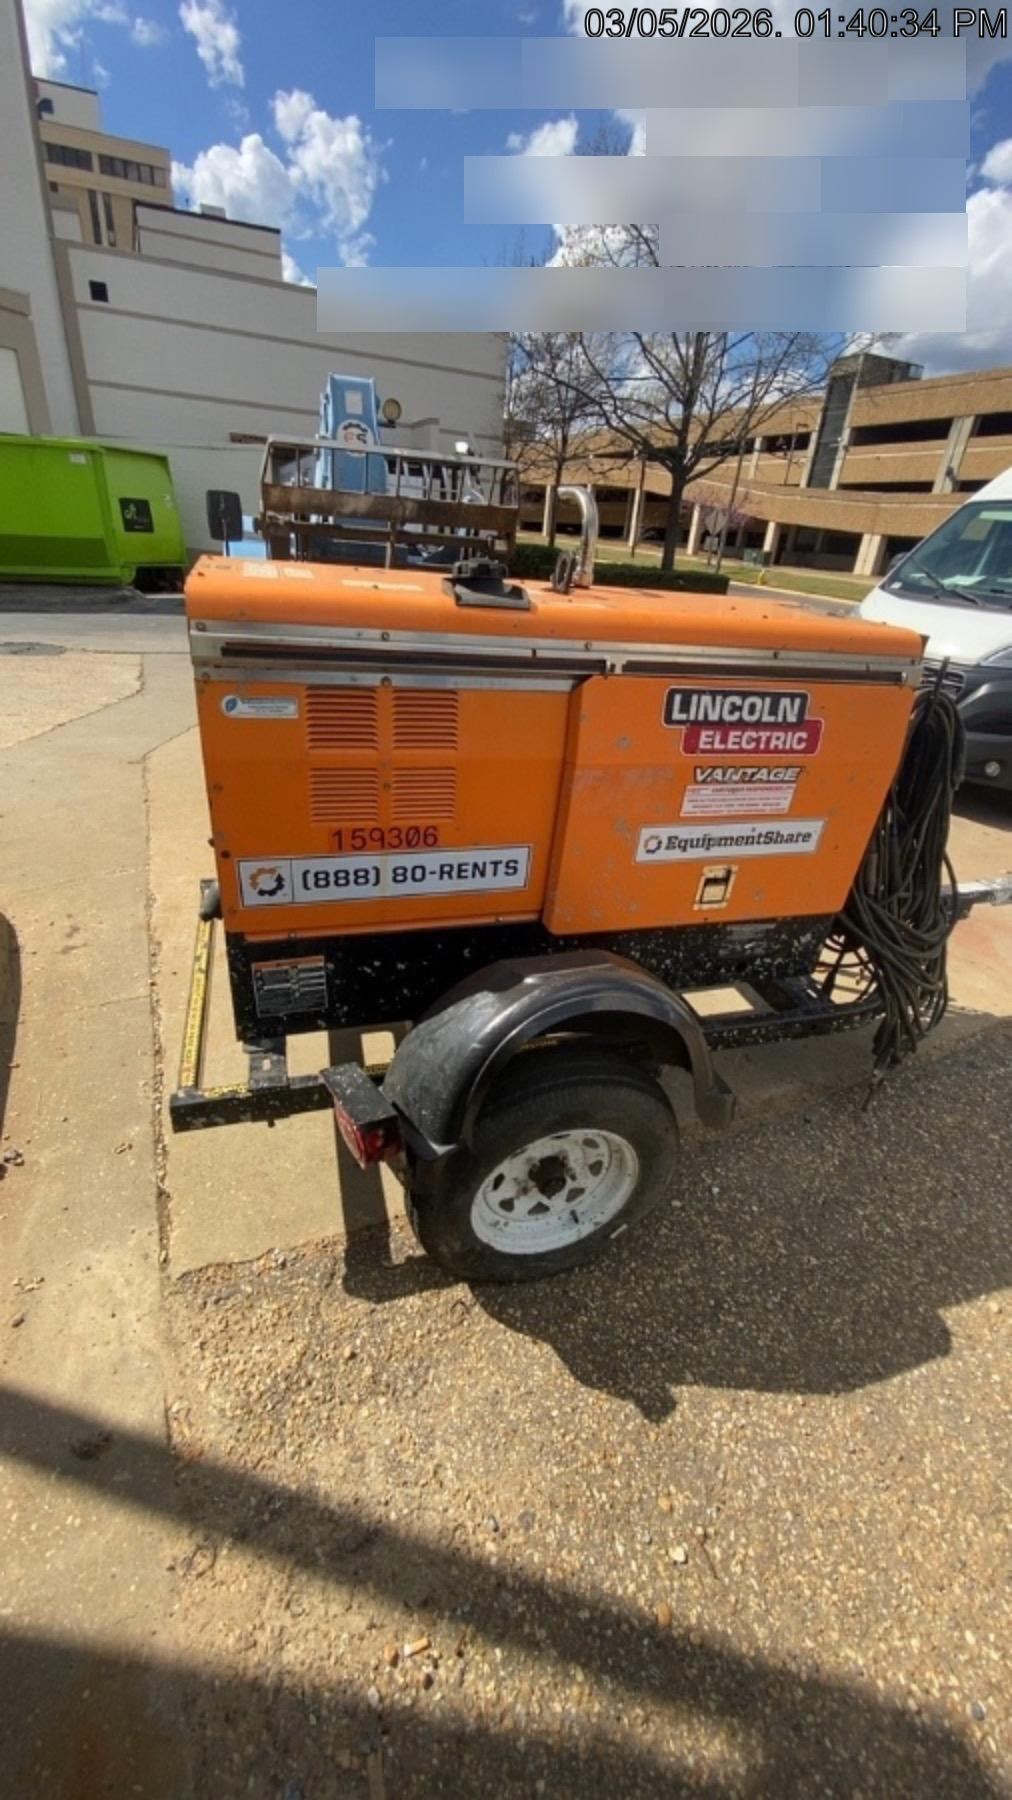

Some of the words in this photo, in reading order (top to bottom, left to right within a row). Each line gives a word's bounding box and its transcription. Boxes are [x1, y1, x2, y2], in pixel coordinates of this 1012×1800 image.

[671, 693, 801, 723] LINCOLN
[698, 730, 808, 750] ELECTRIC
[695, 766, 804, 783] VANTAGE
[331, 825, 438, 850] 159306
[665, 831, 812, 852] EquipmentShare
[302, 866, 381, 891] (888)
[391, 859, 519, 883] 80-RENTS
